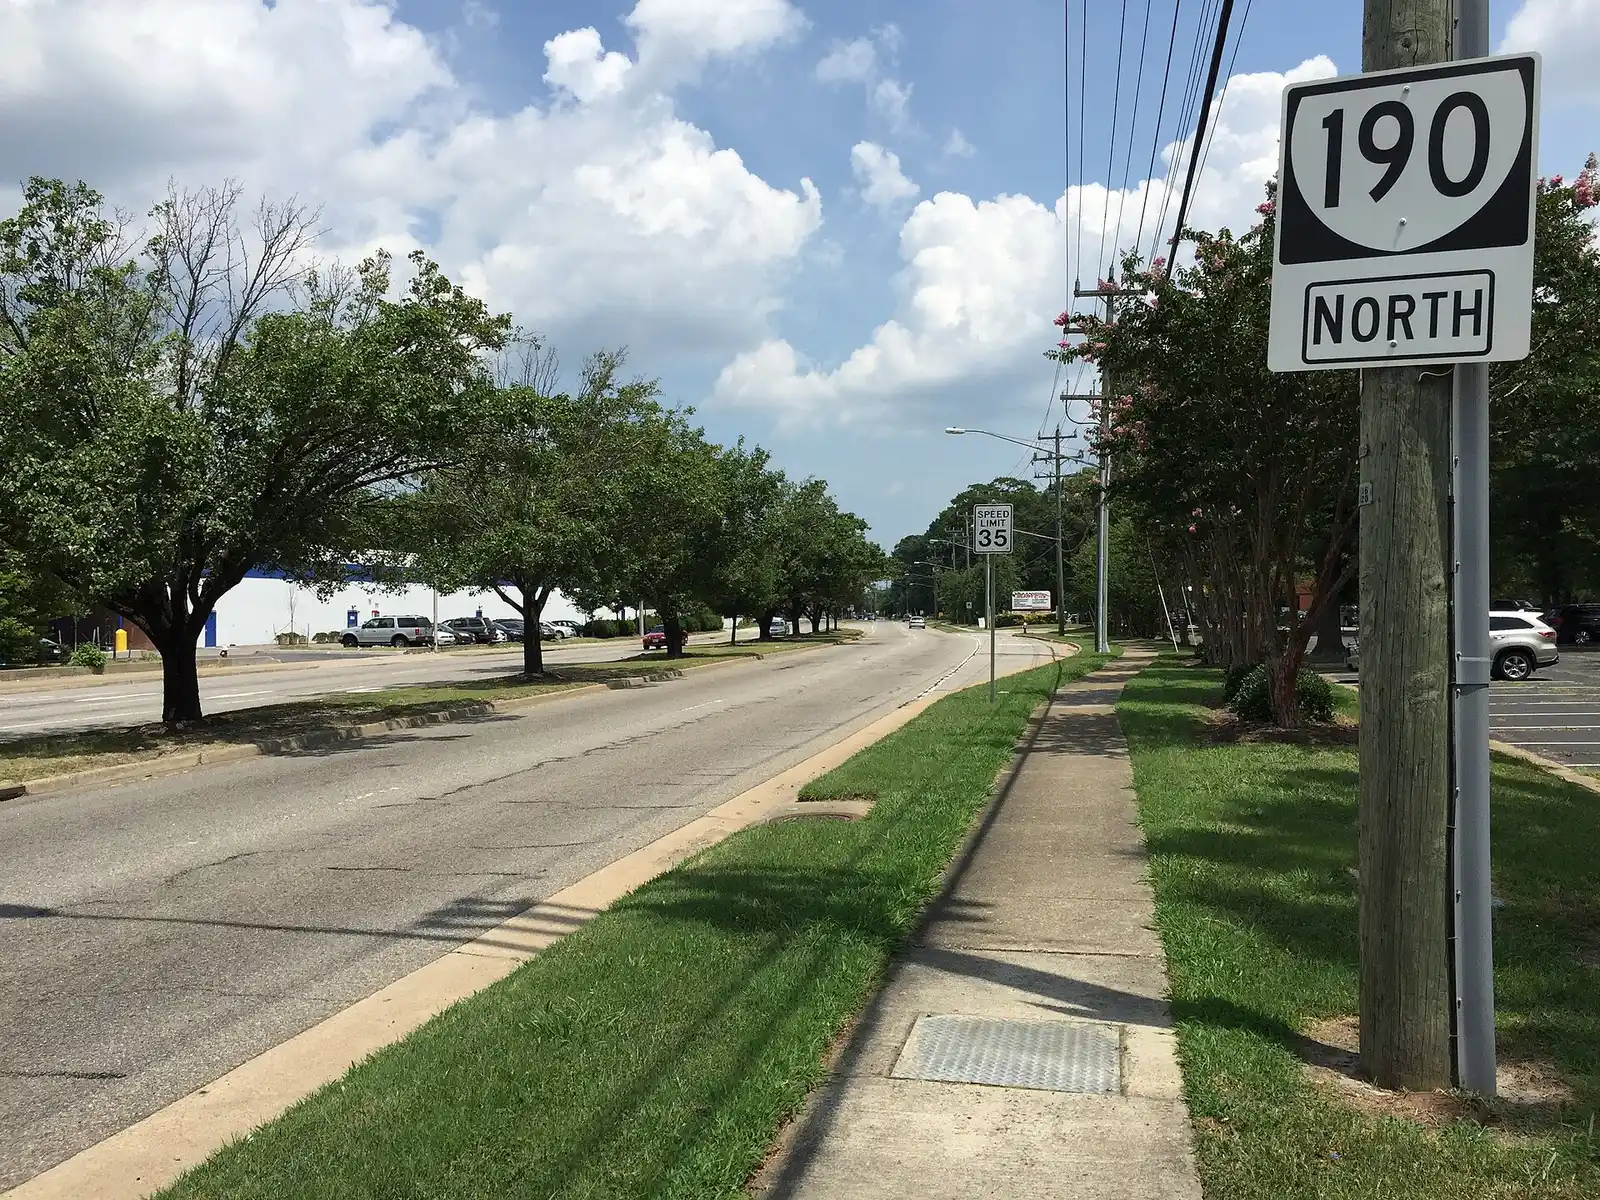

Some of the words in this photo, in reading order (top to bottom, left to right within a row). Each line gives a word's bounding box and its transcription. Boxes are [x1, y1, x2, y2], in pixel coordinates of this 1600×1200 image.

[1321, 91, 1490, 208] 190
[1312, 289, 1483, 345] NORTH
[977, 510, 1010, 518] SPEED
[980, 519, 1006, 527] LIMIT
[978, 529, 1008, 547] 35
